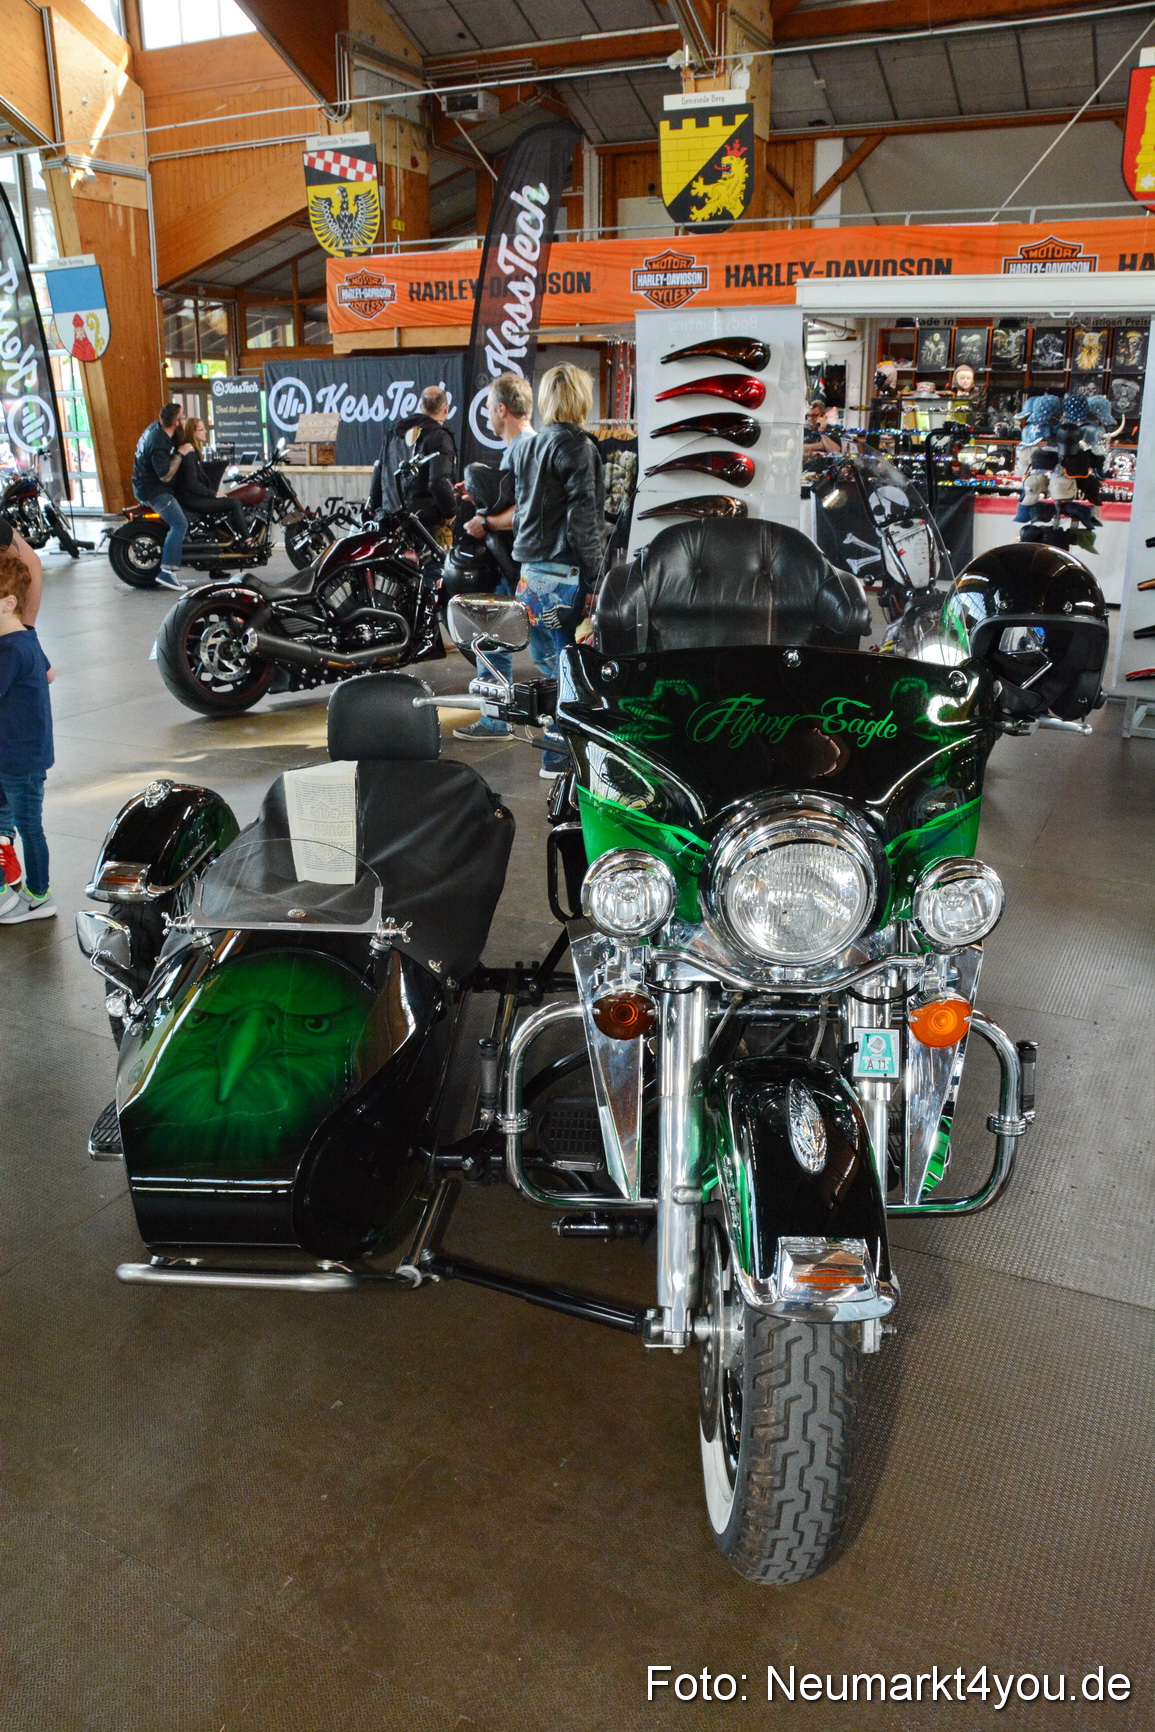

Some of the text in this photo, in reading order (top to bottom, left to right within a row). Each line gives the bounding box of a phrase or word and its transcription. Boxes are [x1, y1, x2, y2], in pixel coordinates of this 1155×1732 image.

[681, 94, 725, 105] Gemeinde Berg
[1028, 244, 1073, 259] MOTOR
[652, 255, 687, 270] MOTOR
[484, 182, 550, 379] KessTech
[637, 271, 703, 287] HARLEY-DAVIDSON
[651, 289, 687, 305] CYCLES
[686, 693, 898, 749] Flying Eagle
